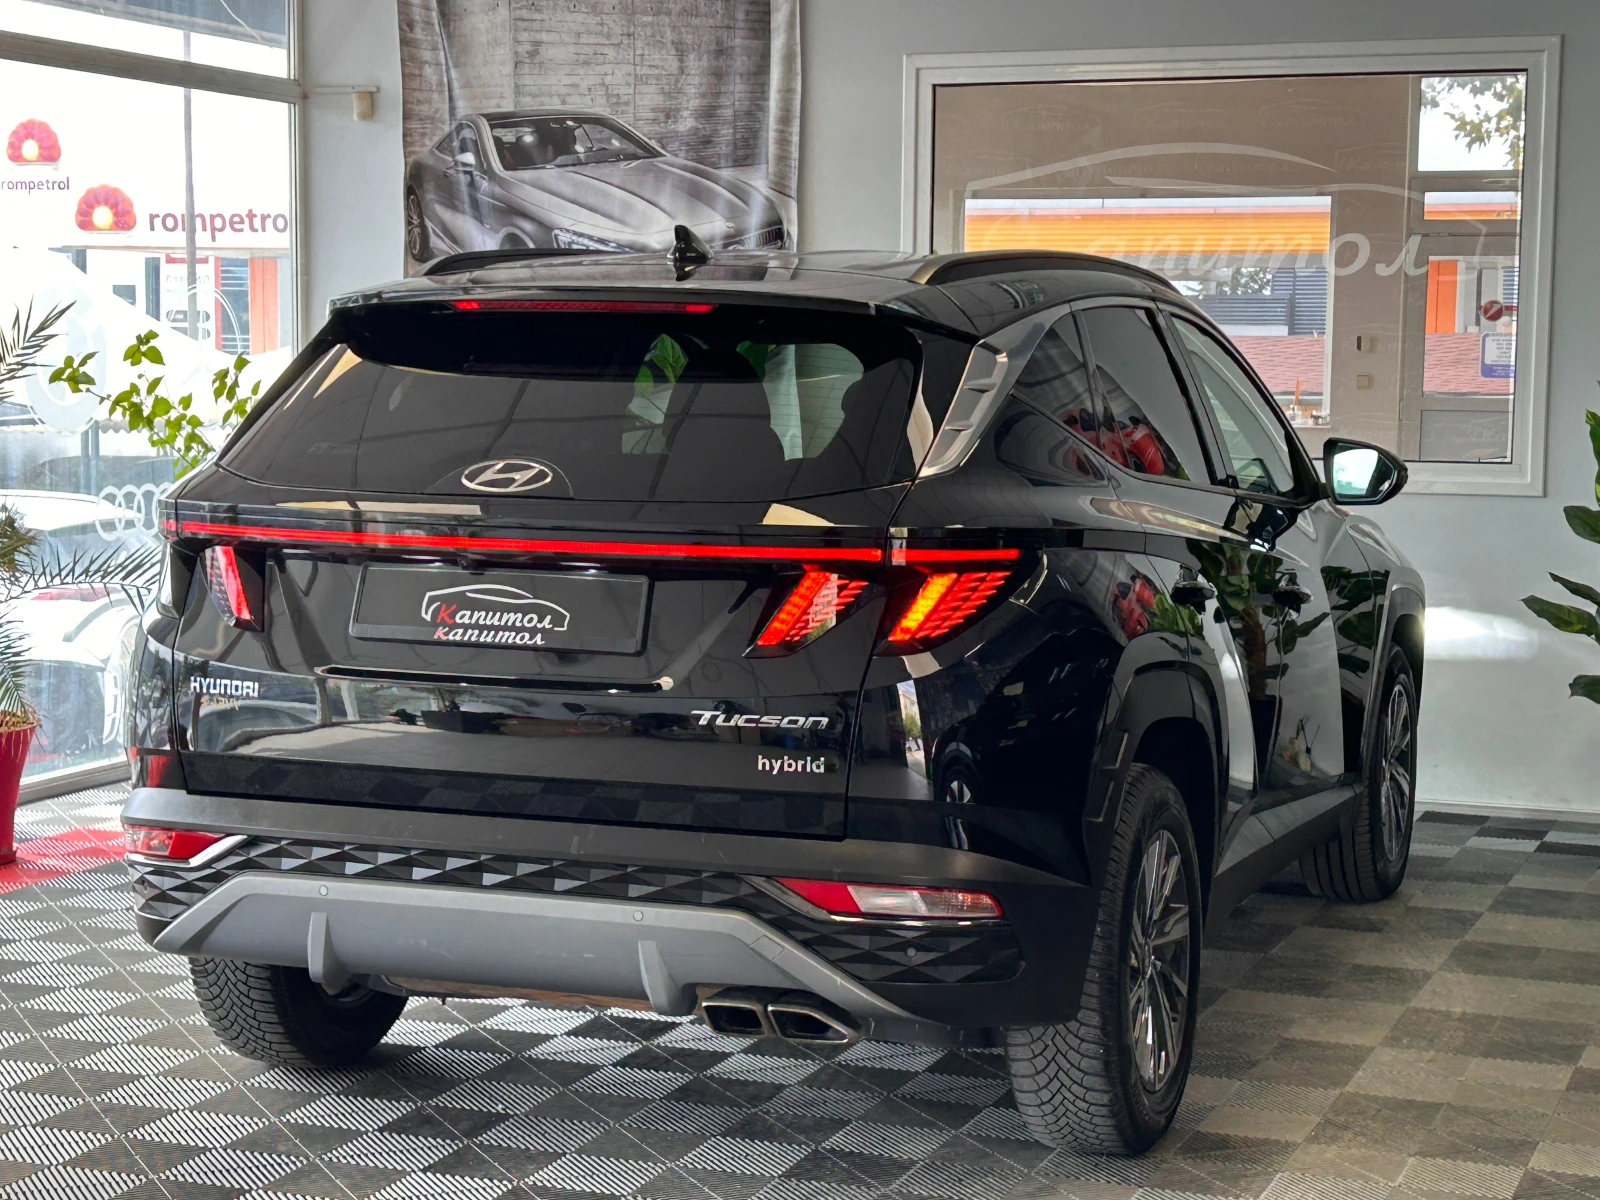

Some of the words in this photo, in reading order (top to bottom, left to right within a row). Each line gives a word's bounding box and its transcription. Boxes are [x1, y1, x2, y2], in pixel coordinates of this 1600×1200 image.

[1, 176, 70, 195] rompetrol
[148, 208, 289, 243] rompetro
[436, 603, 553, 629] Капитол
[189, 676, 260, 698] HYUNDAI
[690, 710, 830, 730] Tucson
[757, 754, 825, 775] hybrid
